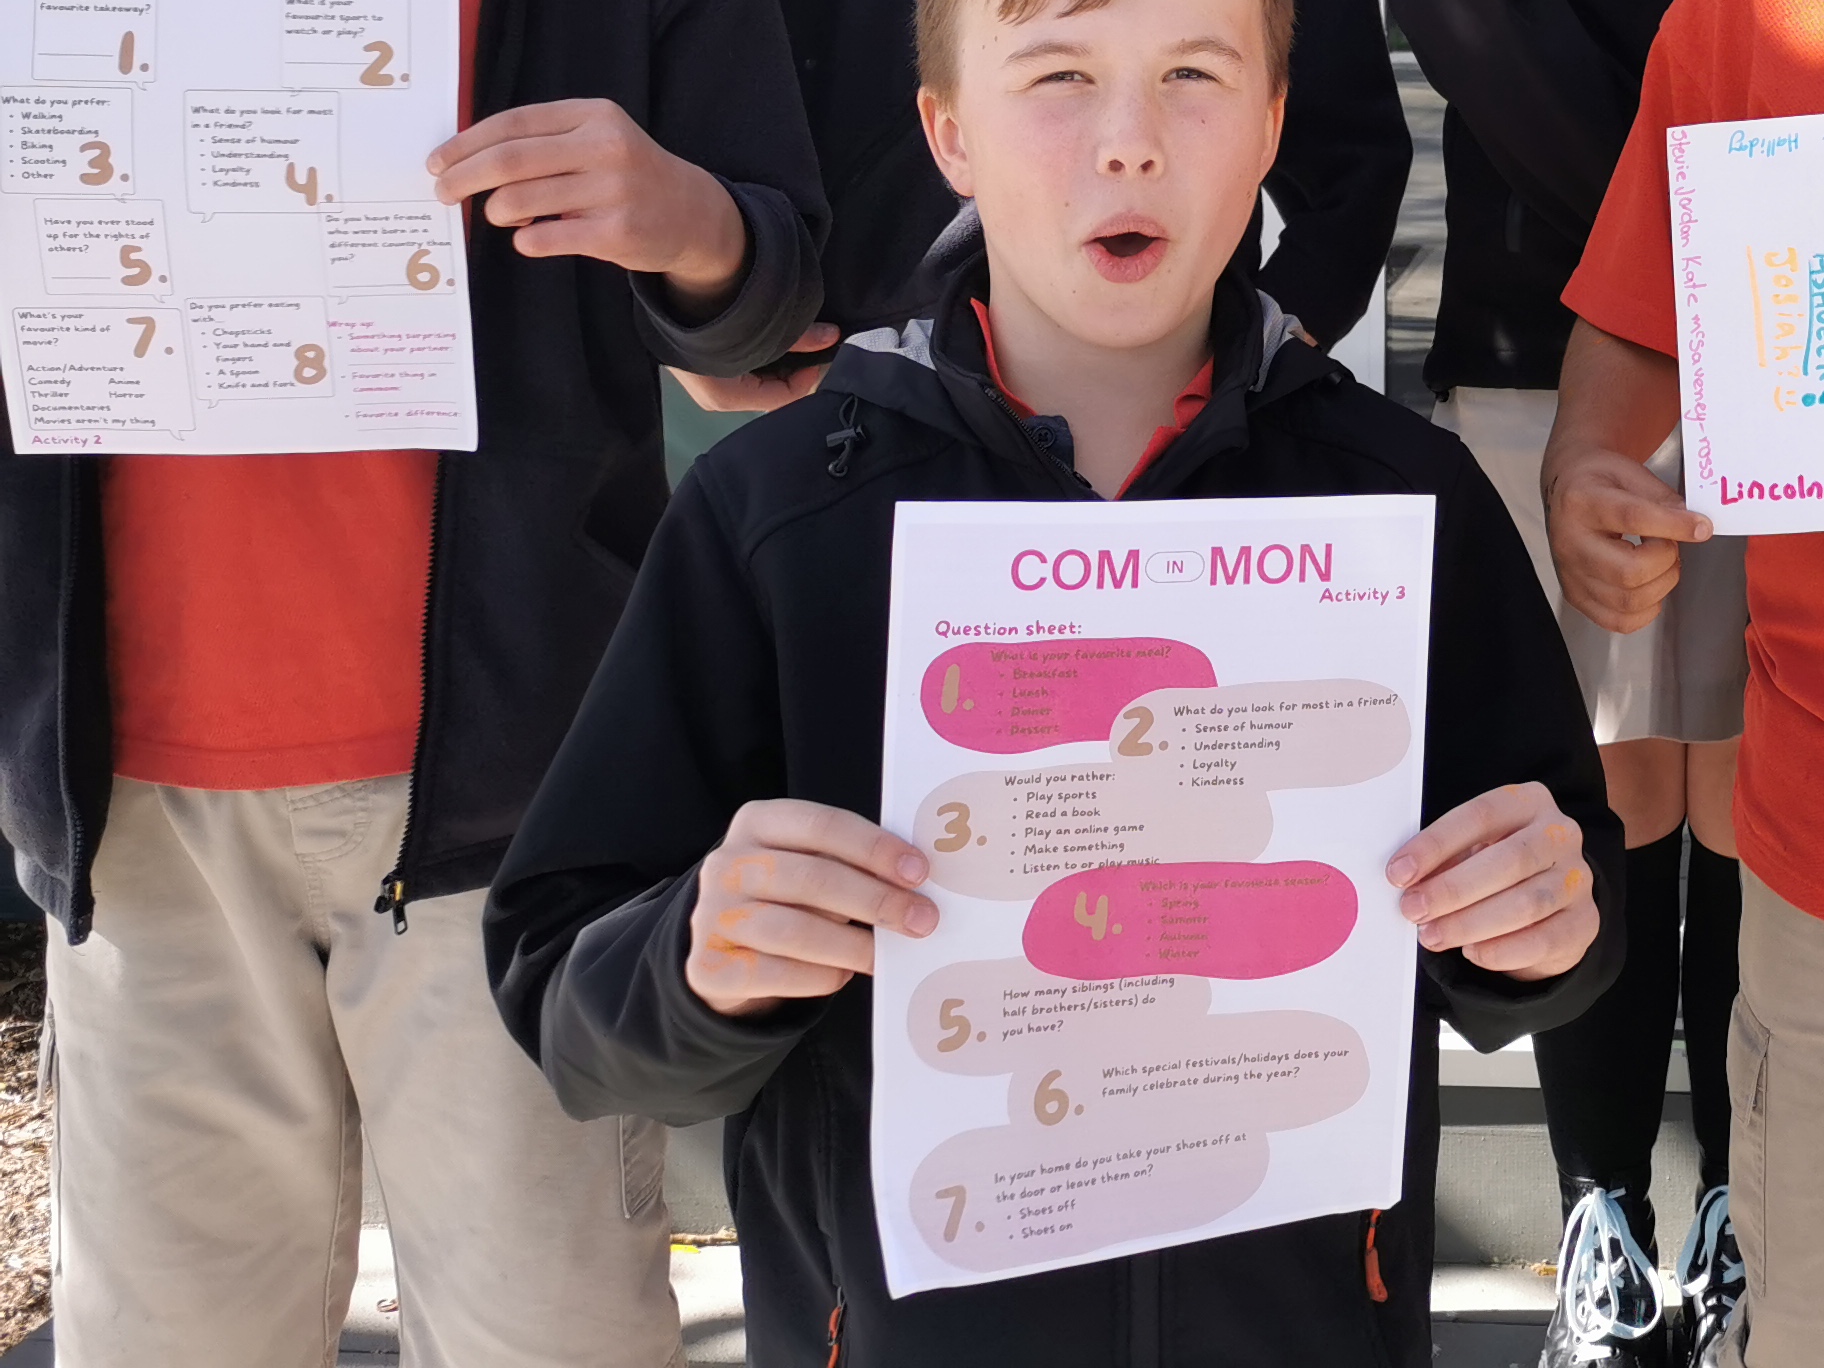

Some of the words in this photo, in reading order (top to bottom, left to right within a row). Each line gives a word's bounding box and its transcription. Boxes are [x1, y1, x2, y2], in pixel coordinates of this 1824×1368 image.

[20, 111, 64, 123] Walking
[20, 125, 100, 139] Skateboarding
[20, 140, 54, 153] Biking
[20, 156, 68, 168] Scooting
[21, 170, 55, 180] Other
[27, 376, 72, 388] Comedy
[107, 377, 141, 386] Anime
[29, 390, 70, 399] Thriller
[108, 390, 146, 399] Horror
[31, 434, 89, 449] Activity
[93, 434, 103, 445] 2
[1011, 549, 1140, 591] COM
[1167, 560, 1183, 574] IN
[1210, 543, 1332, 586] MON
[1319, 588, 1389, 606] Activity
[1396, 586, 1405, 600] 3
[935, 621, 1018, 638] Question
[1026, 620, 1081, 636] sheet:
[940, 664, 974, 714] 1.
[1173, 704, 1206, 717] What
[1209, 703, 1224, 715] do
[1226, 705, 1248, 719] you
[1251, 701, 1275, 713] look
[1278, 701, 1298, 712] for
[1301, 700, 1330, 710] most
[1333, 699, 1344, 709] in
[1346, 700, 1354, 708] a
[1357, 693, 1399, 708] friend?
[1113, 702, 1168, 756] 2.
[1194, 723, 1230, 734] Sense
[1232, 721, 1247, 732] of
[1249, 719, 1294, 731] humour
[1194, 737, 1280, 751] Understanding
[1193, 758, 1237, 772] Loyalty
[1004, 772, 1042, 787] Would
[1045, 774, 1067, 787] you
[1070, 770, 1116, 783] rather:
[1191, 775, 1245, 788] Kindness
[1026, 791, 1054, 805] Play
[1057, 790, 1097, 804] sports
[1025, 806, 1057, 821] Read
[1060, 810, 1068, 818] a
[1071, 806, 1101, 817] book
[934, 802, 987, 853] 3.
[1024, 826, 1052, 841] Play
[1055, 828, 1071, 836] an
[1074, 824, 1110, 835] online
[1112, 824, 1145, 837] game
[1023, 843, 1060, 857] Make
[1062, 839, 1125, 853] something
[1074, 891, 1122, 940] 4.
[937, 998, 987, 1053] 5.
[1034, 1069, 1084, 1126] 6.
[935, 1185, 985, 1243] 7.
